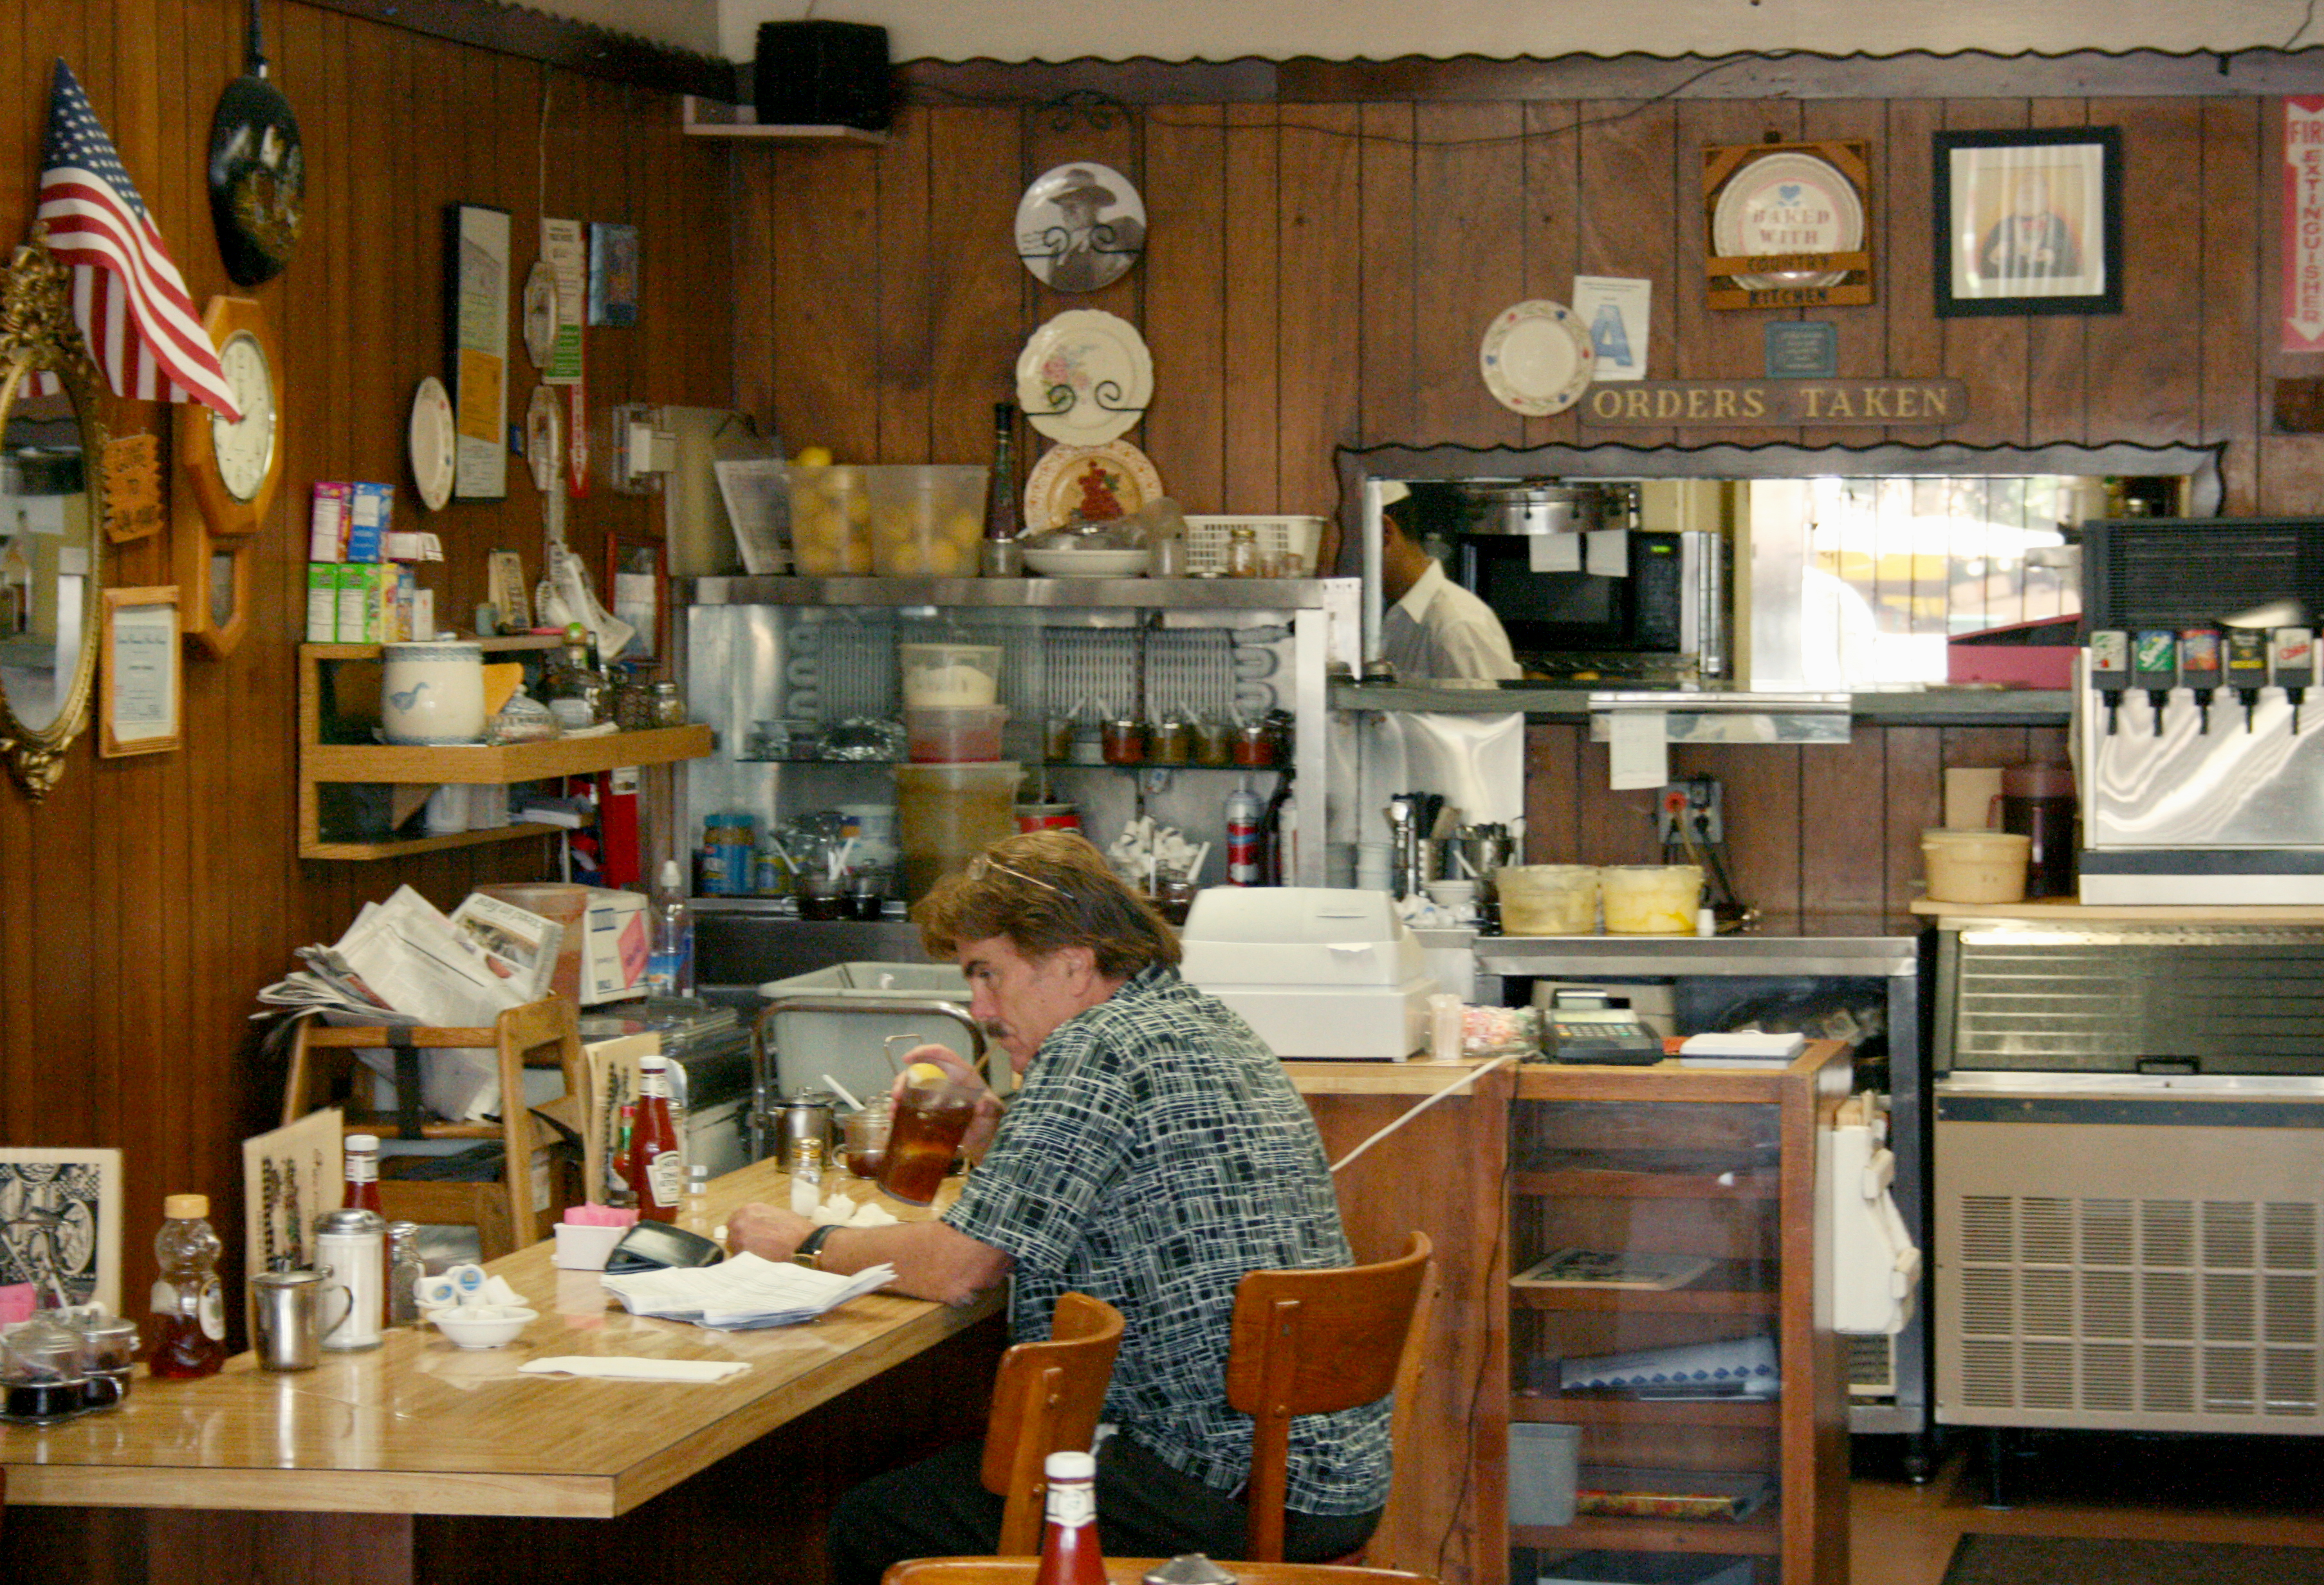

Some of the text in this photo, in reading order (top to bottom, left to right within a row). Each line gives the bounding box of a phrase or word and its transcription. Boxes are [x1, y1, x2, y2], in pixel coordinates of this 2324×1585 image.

[2290, 120, 2323, 144] FIR
[1753, 209, 1831, 223] BAKED
[1758, 229, 1819, 245] WITH
[2303, 149, 2321, 321] EXTINGUISHER
[1749, 288, 1829, 307] KITCHEN
[1590, 304, 1633, 367] A
[1592, 386, 1948, 418] ORDERS TAKEN
